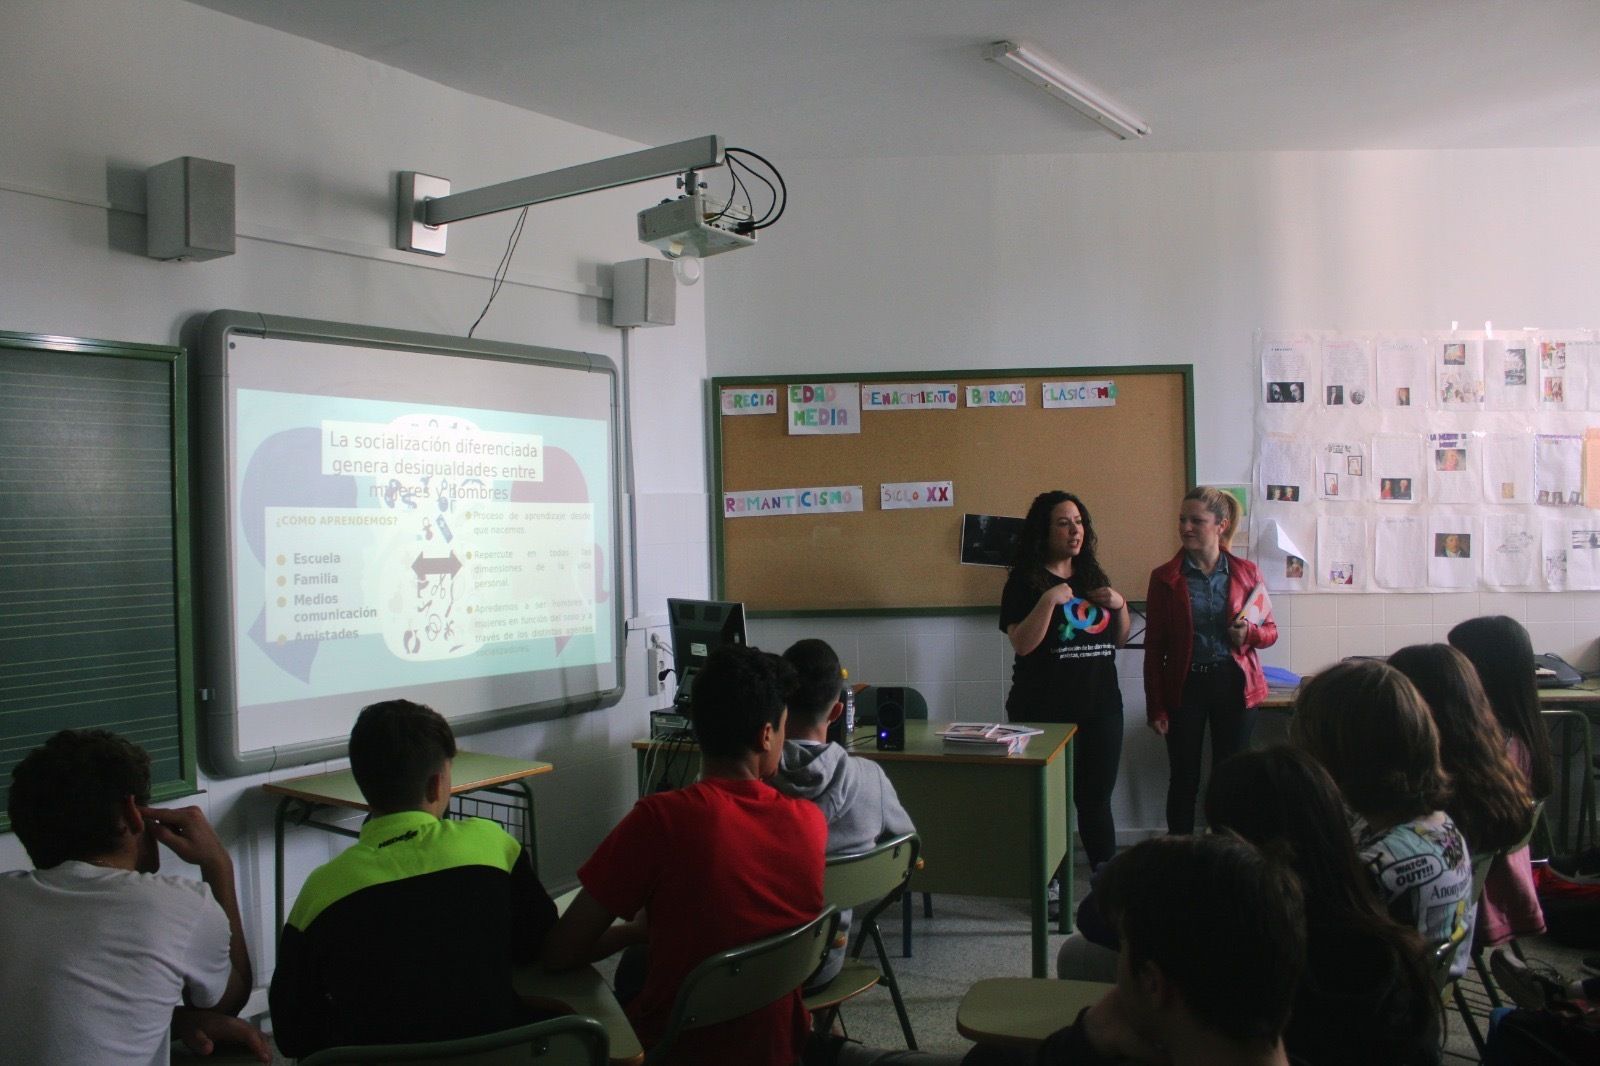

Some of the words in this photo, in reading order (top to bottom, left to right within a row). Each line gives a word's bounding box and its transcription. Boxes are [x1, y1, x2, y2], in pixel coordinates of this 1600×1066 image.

[722, 392, 774, 409] GRECIA
[790, 385, 837, 404] EDAD
[971, 388, 1024, 404] BARROCO
[1043, 384, 1119, 401] CLASICISMO
[794, 408, 848, 426] MEDIA
[330, 431, 348, 448] La
[354, 433, 451, 453] socialización
[456, 439, 538, 458] diferenciada
[332, 459, 389, 476] genera
[394, 459, 498, 478] desigualdades
[502, 464, 536, 479] entre
[725, 490, 852, 512] ROMANTICISMO
[927, 486, 949, 502] XX
[276, 515, 316, 528] ¿COMO
[320, 516, 398, 526] APRENDEMOS?
[474, 511, 504, 520] Proceso
[509, 511, 519, 520] de
[293, 553, 341, 565] Escuela
[293, 573, 339, 585] Familia
[294, 593, 339, 606] Medios
[294, 607, 377, 623] comunicación
[295, 629, 359, 642] Amistades
[503, 631, 514, 640] de
[1394, 857, 1428, 874] WATCH
[1395, 864, 1434, 886] OUT!!!
